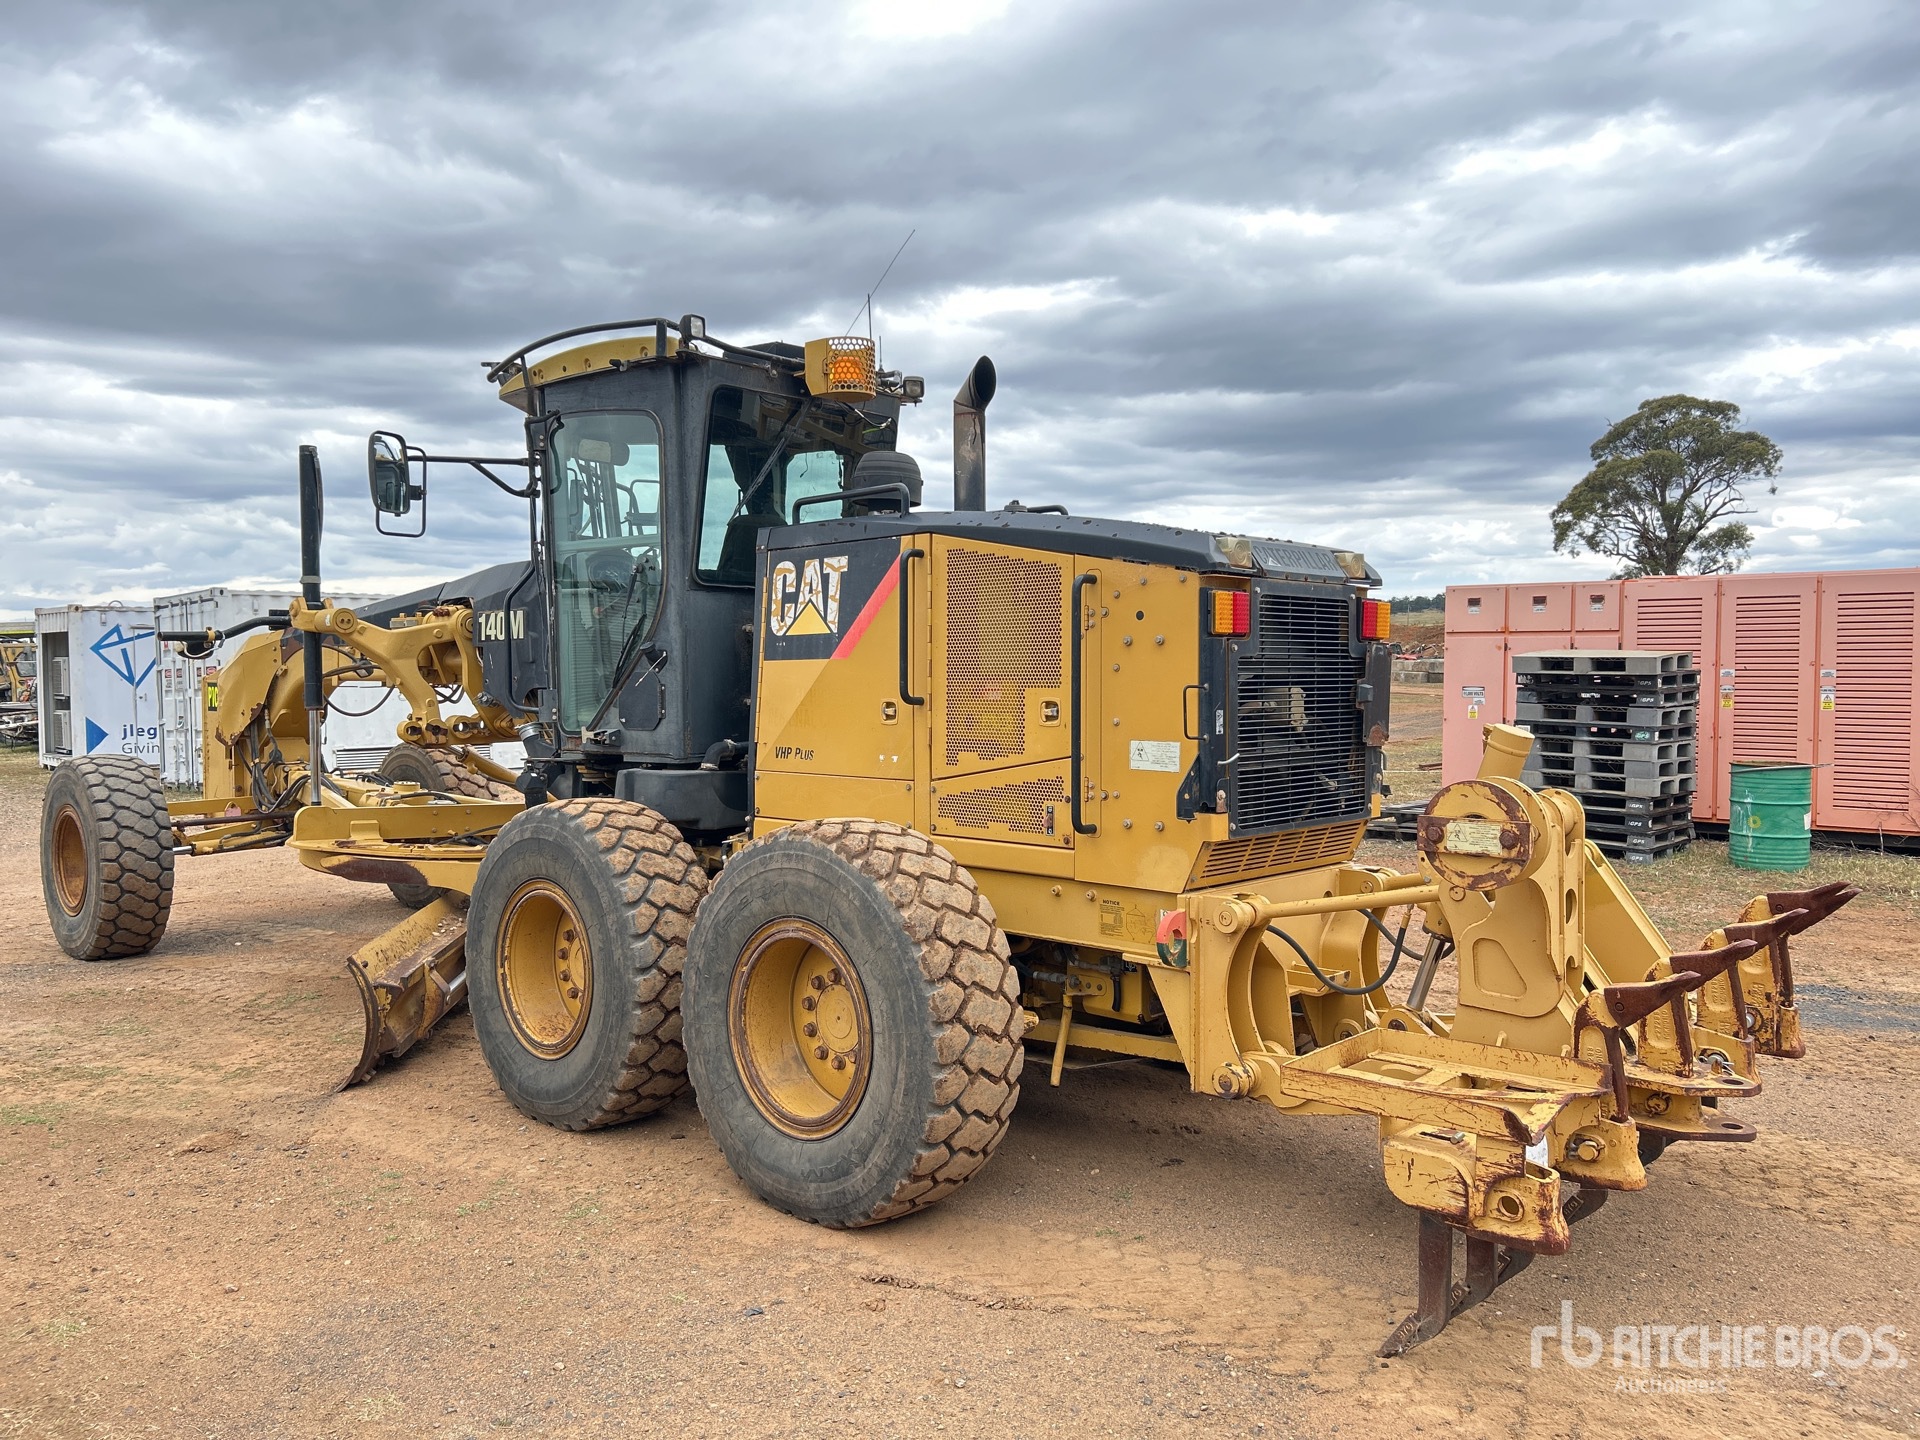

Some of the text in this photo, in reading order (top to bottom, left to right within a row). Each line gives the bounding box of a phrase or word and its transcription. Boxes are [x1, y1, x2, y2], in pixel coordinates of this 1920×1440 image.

[1253, 545, 1339, 571] CATERPILLAR
[770, 555, 849, 637] CAT
[775, 746, 792, 760] VHP
